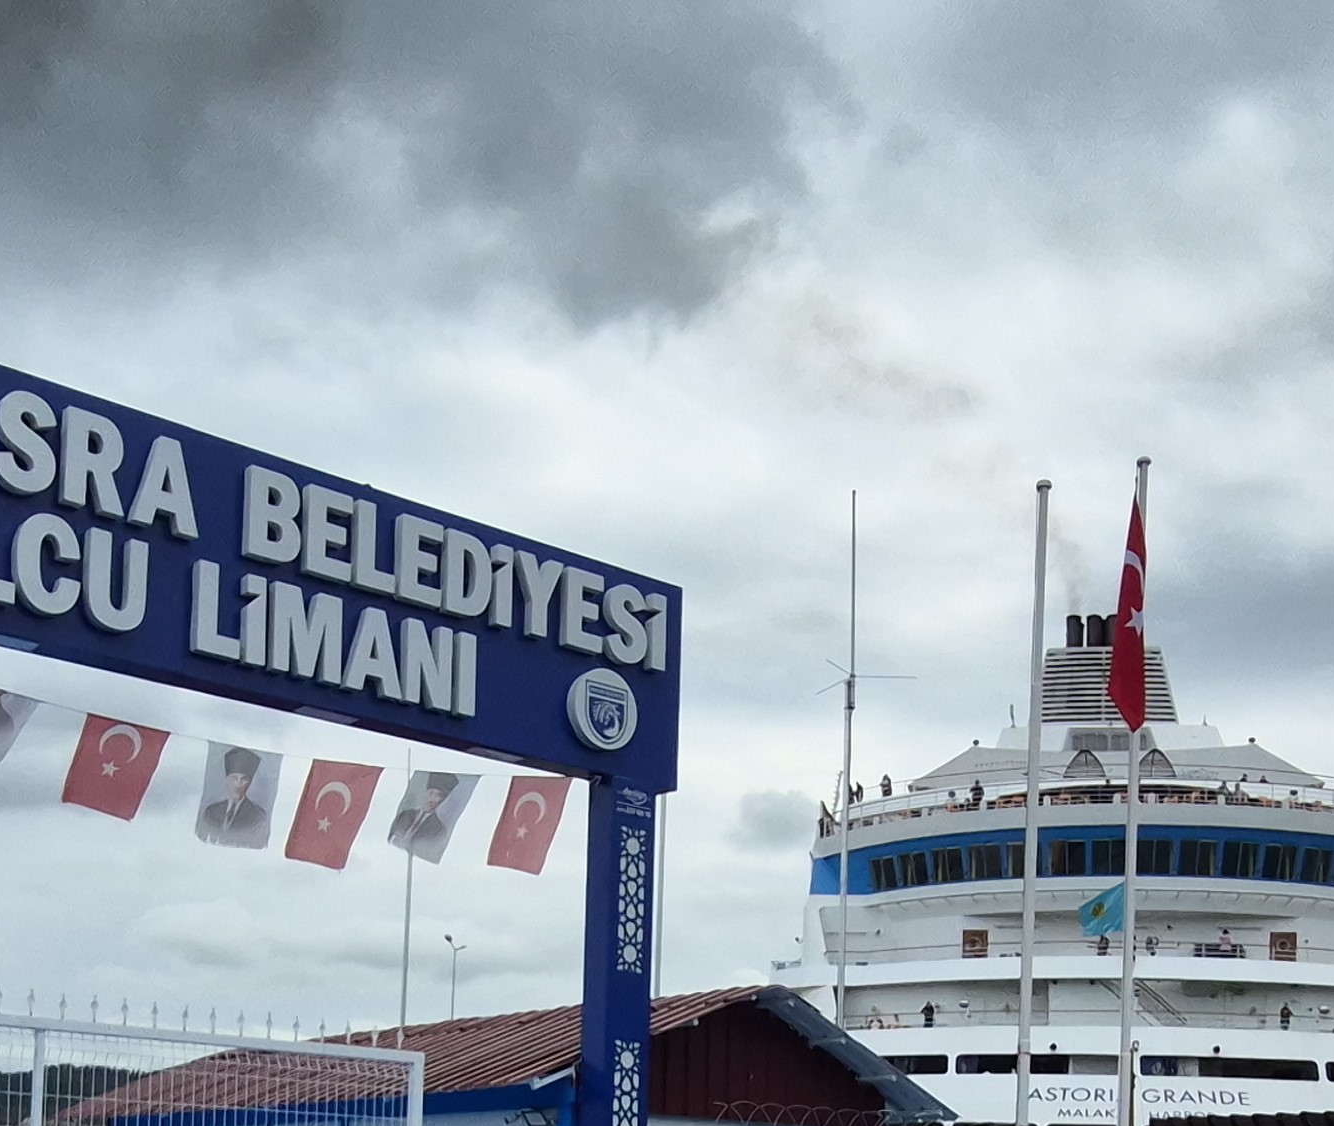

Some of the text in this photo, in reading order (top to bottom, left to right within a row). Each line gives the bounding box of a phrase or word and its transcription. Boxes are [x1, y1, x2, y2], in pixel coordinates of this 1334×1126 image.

[241, 463, 666, 672] BELEDİYESİ
[189, 560, 477, 718] LİMANI
[1028, 1087, 1251, 1106] ASTORI GRANDE
[1057, 1108, 1115, 1118] MALAK
